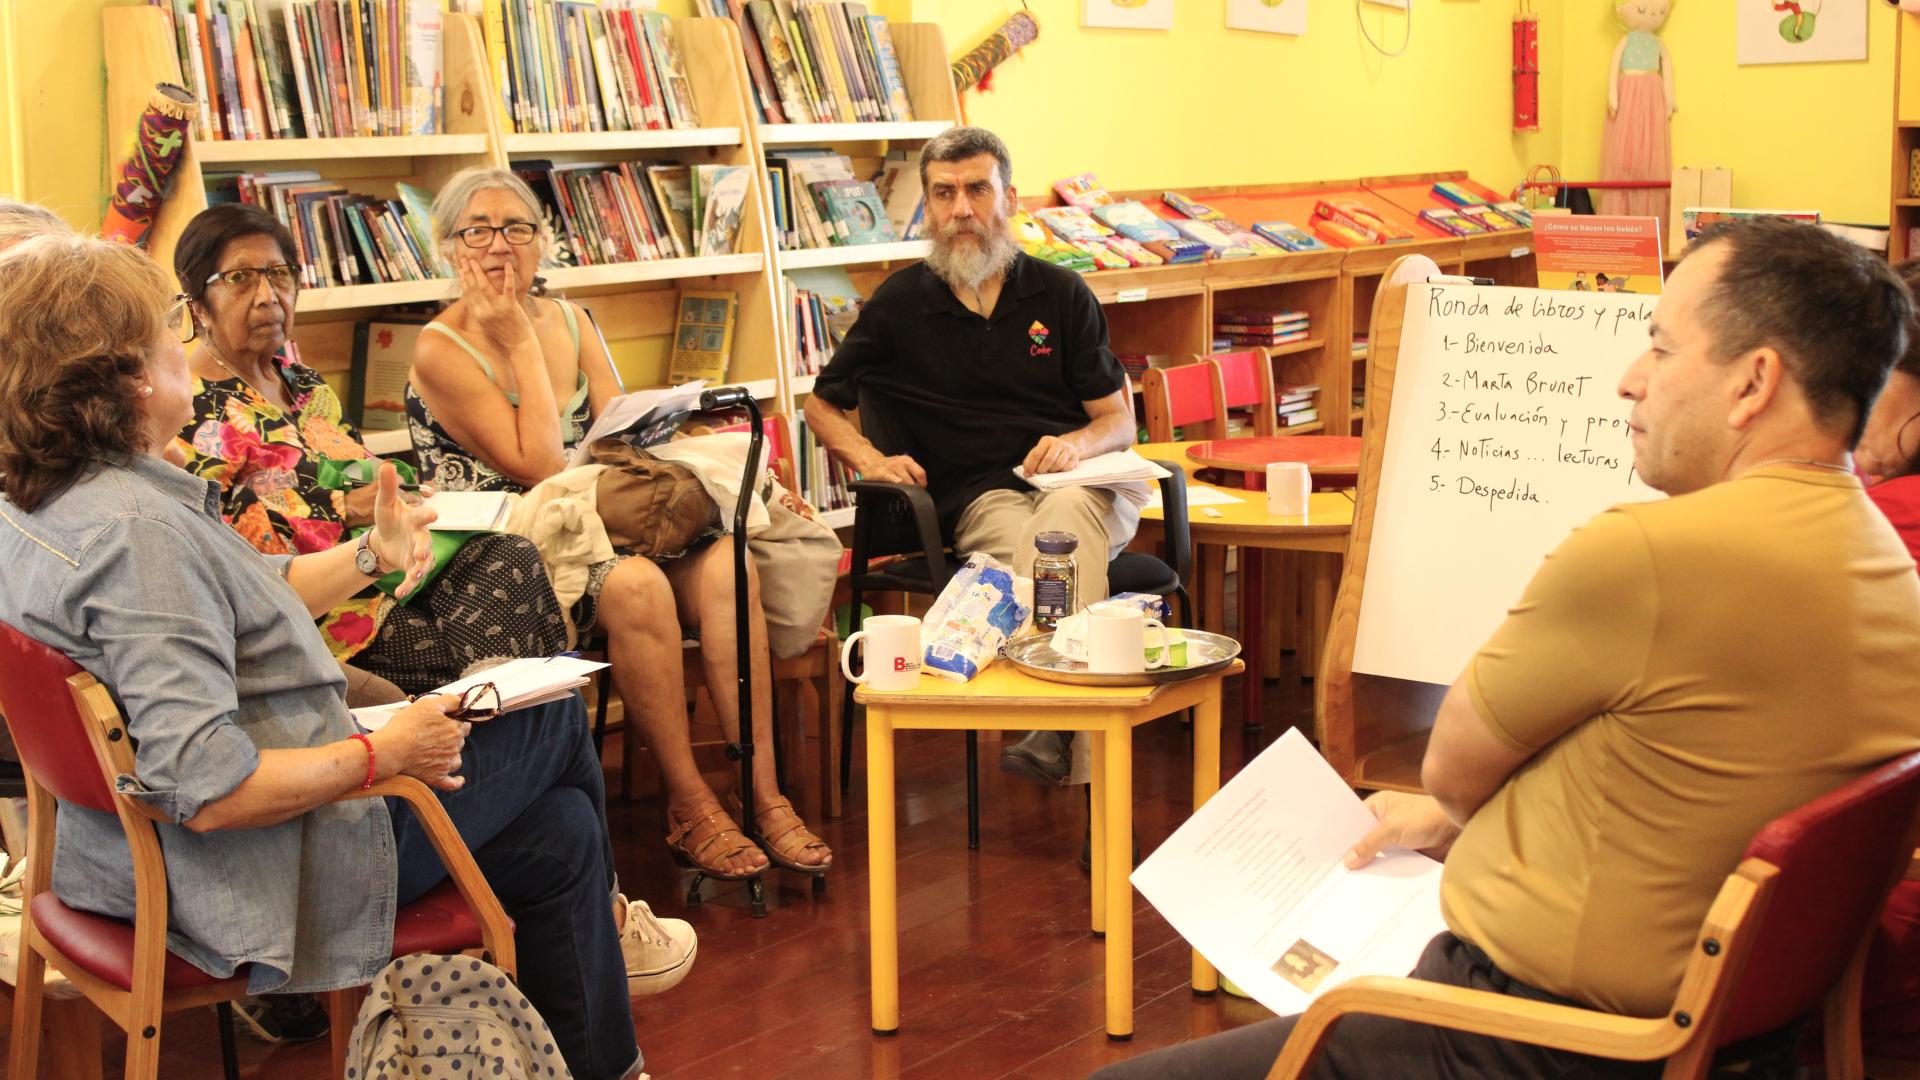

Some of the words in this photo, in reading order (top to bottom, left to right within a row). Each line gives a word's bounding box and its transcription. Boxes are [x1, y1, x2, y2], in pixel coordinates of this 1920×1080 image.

[1430, 287, 1489, 317] Ronda
[1504, 296, 1523, 318] de
[1533, 296, 1585, 320] libros
[1594, 308, 1606, 330] y
[1464, 332, 1558, 355] Bienvenida
[1561, 418, 1568, 437] y
